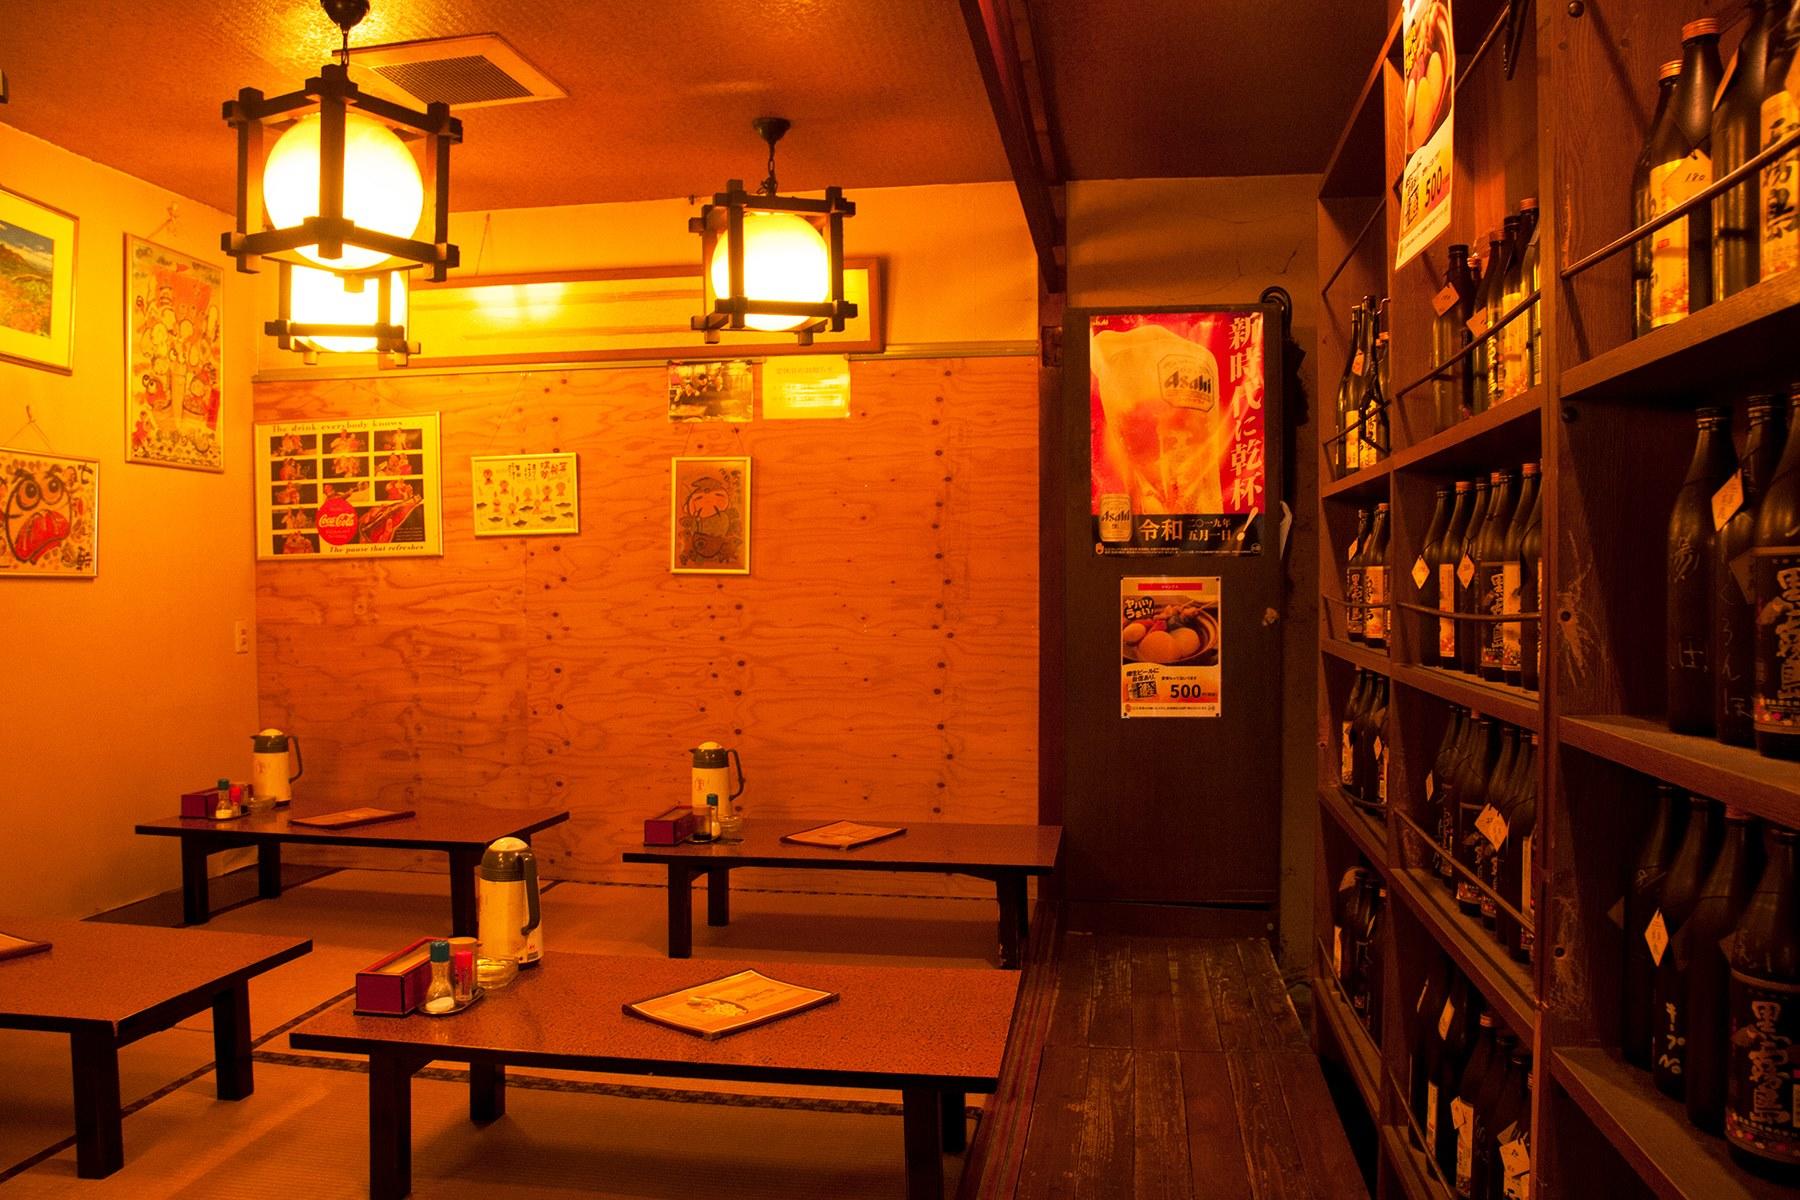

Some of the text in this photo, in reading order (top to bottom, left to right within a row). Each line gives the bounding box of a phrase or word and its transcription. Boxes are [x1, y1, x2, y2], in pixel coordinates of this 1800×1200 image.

[1164, 371, 1211, 394] Asahi
[291, 424, 316, 432] drink
[321, 421, 367, 431] everybody
[1101, 510, 1130, 522] Asahi
[1138, 518, 1182, 541] 令和
[1188, 529, 1231, 541] 五月一日
[345, 545, 369, 554] pause
[371, 544, 386, 552] that
[1170, 684, 1201, 699] 500
